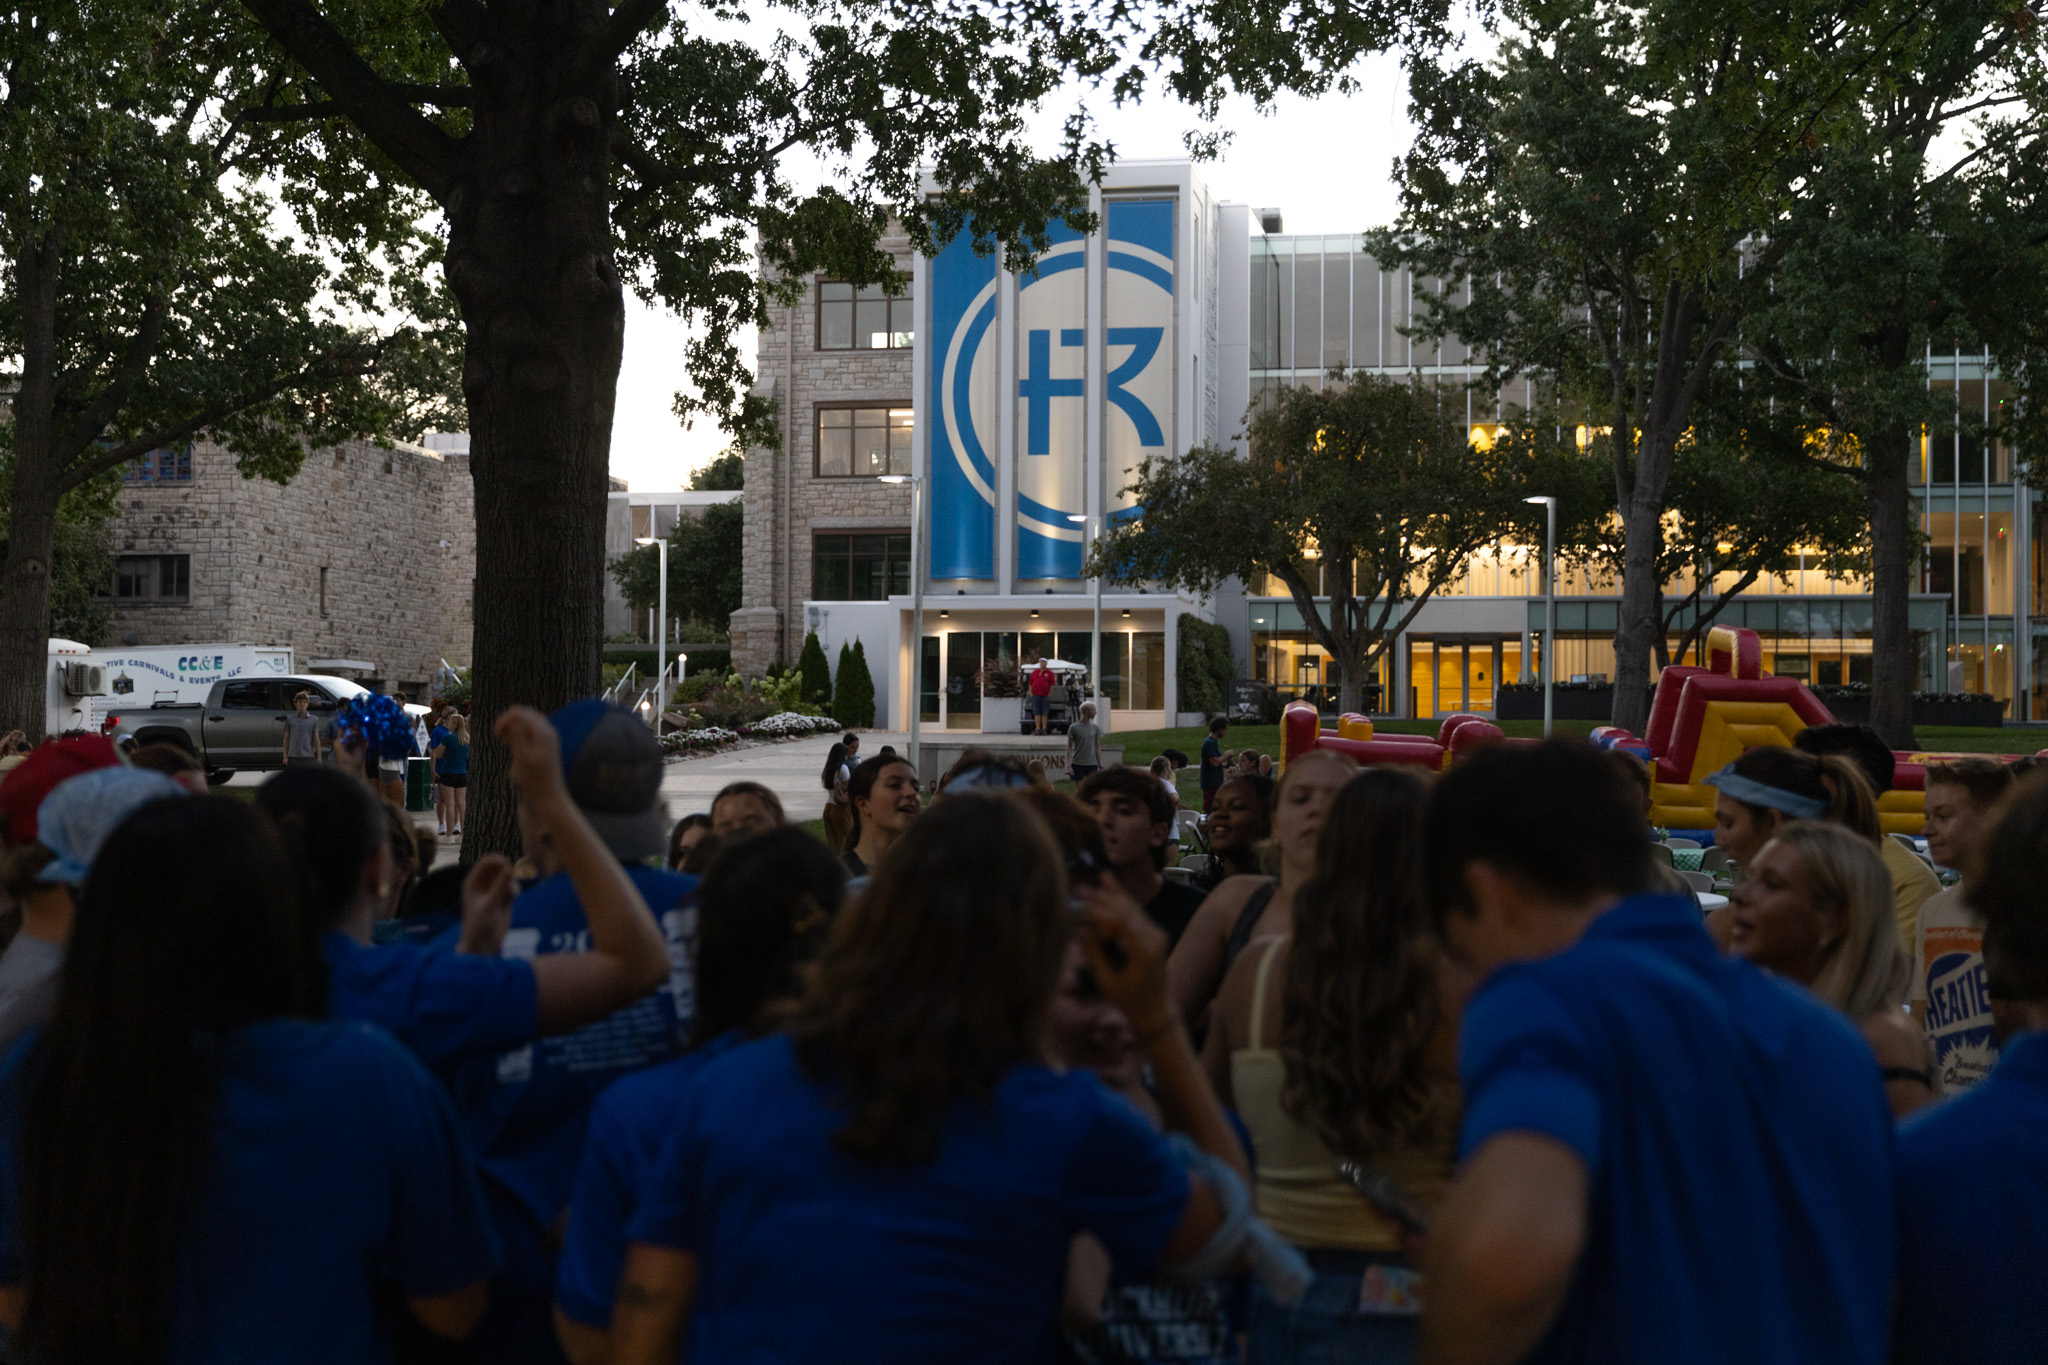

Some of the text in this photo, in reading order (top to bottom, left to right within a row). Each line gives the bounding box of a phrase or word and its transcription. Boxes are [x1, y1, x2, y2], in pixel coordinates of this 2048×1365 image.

[105, 659, 125, 668] TIVE
[128, 659, 175, 680] CARNIVALS
[228, 666, 242, 678] LLC
[178, 655, 224, 672] CC&E
[1924, 963, 1992, 1032] HEATIE
